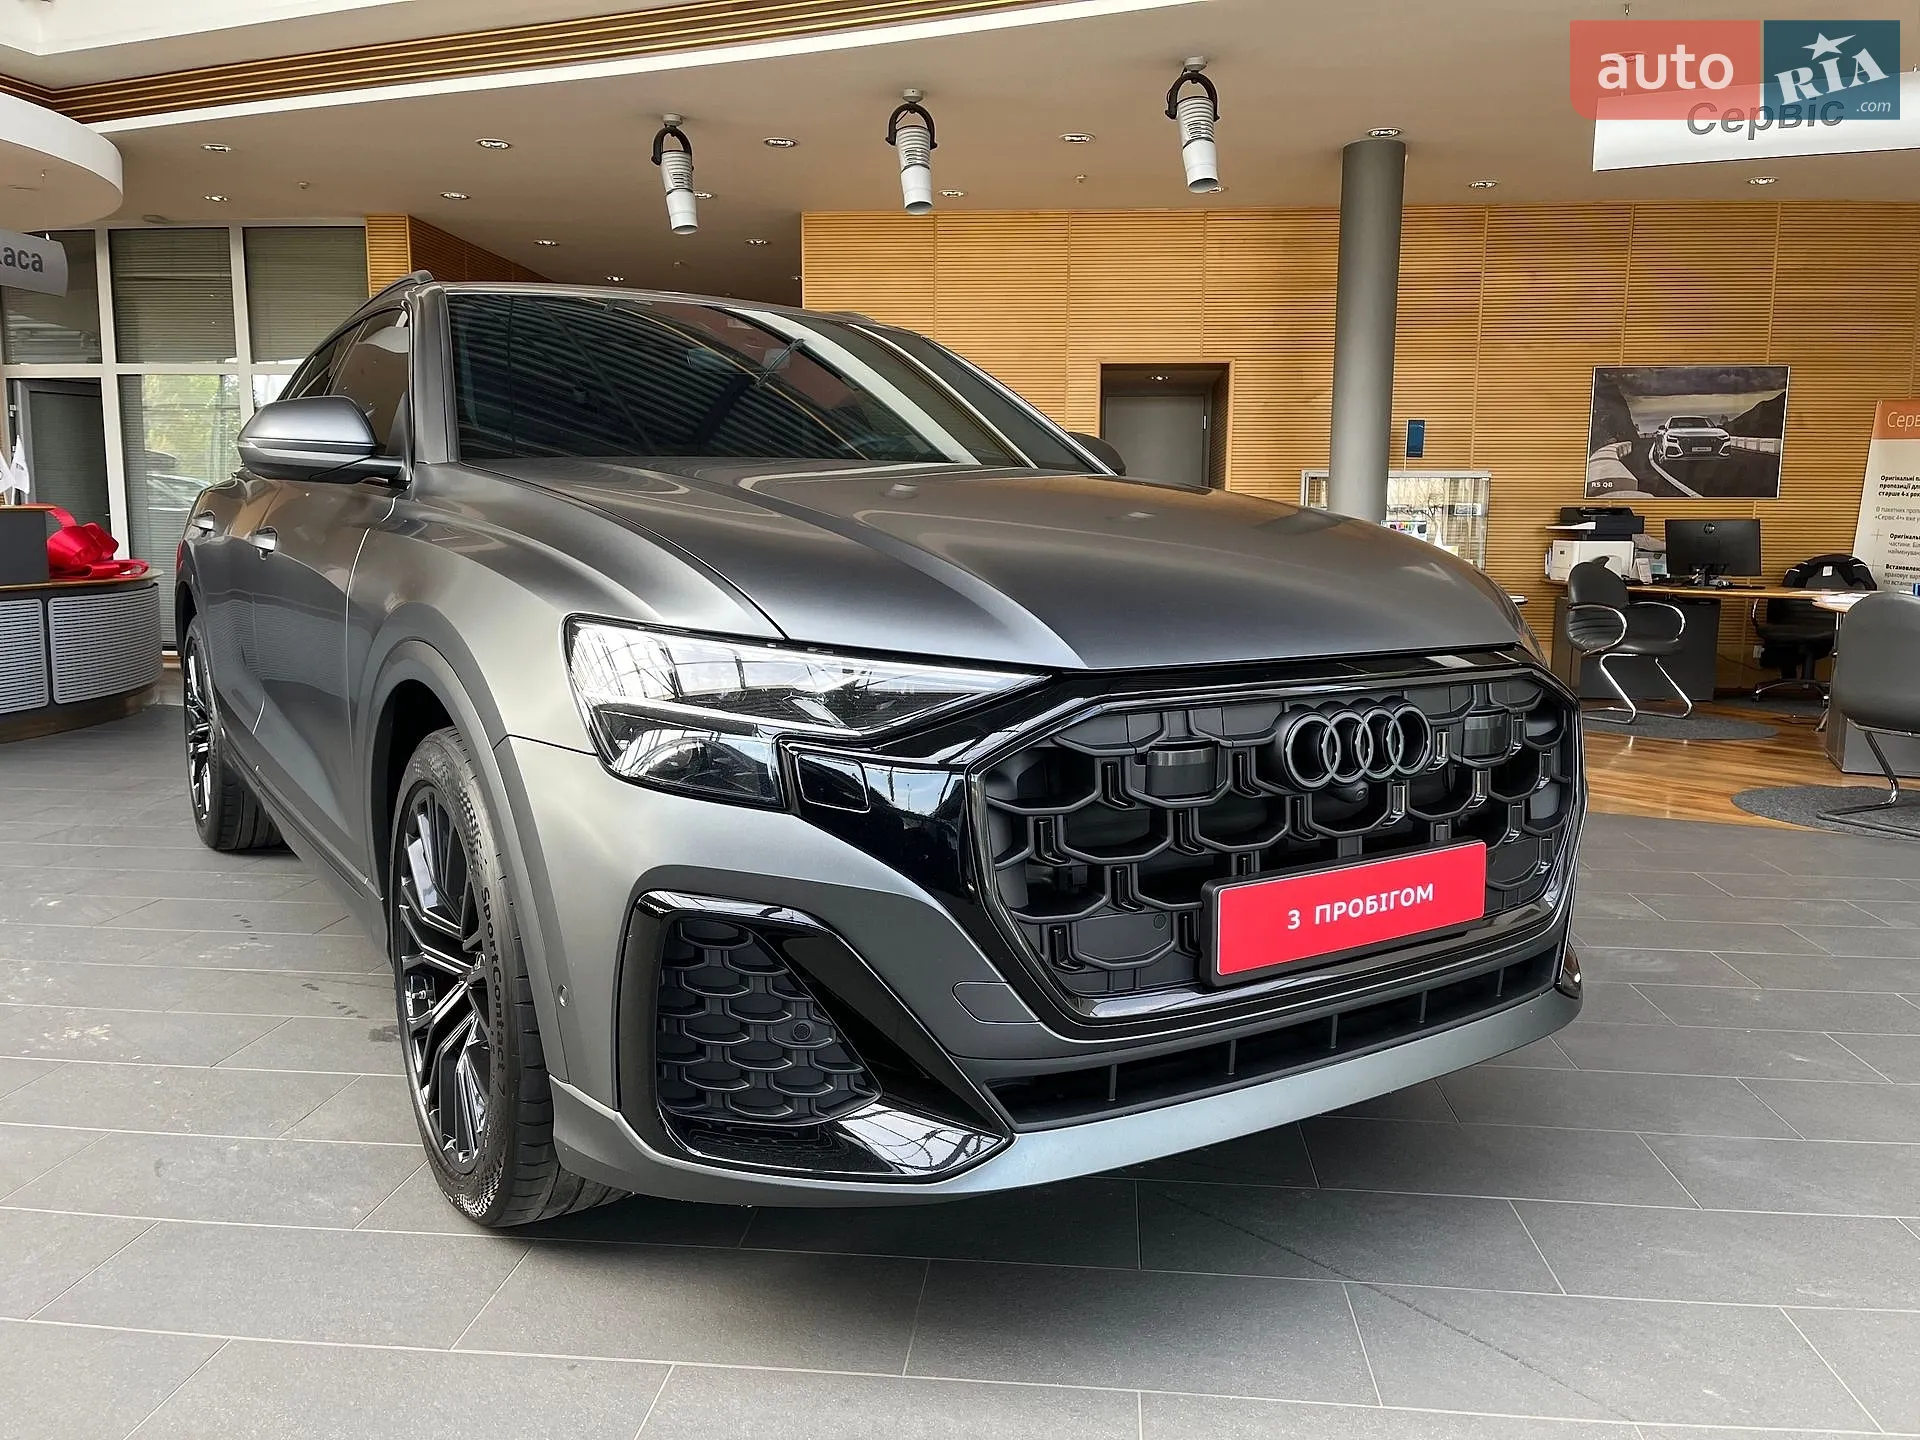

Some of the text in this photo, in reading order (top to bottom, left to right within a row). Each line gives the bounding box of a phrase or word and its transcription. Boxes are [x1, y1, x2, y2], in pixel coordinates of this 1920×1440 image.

[0, 246, 43, 273] аса
[1287, 883, 1434, 930] З ПРОБІГОМ
[481, 886, 505, 1073] SportContact
